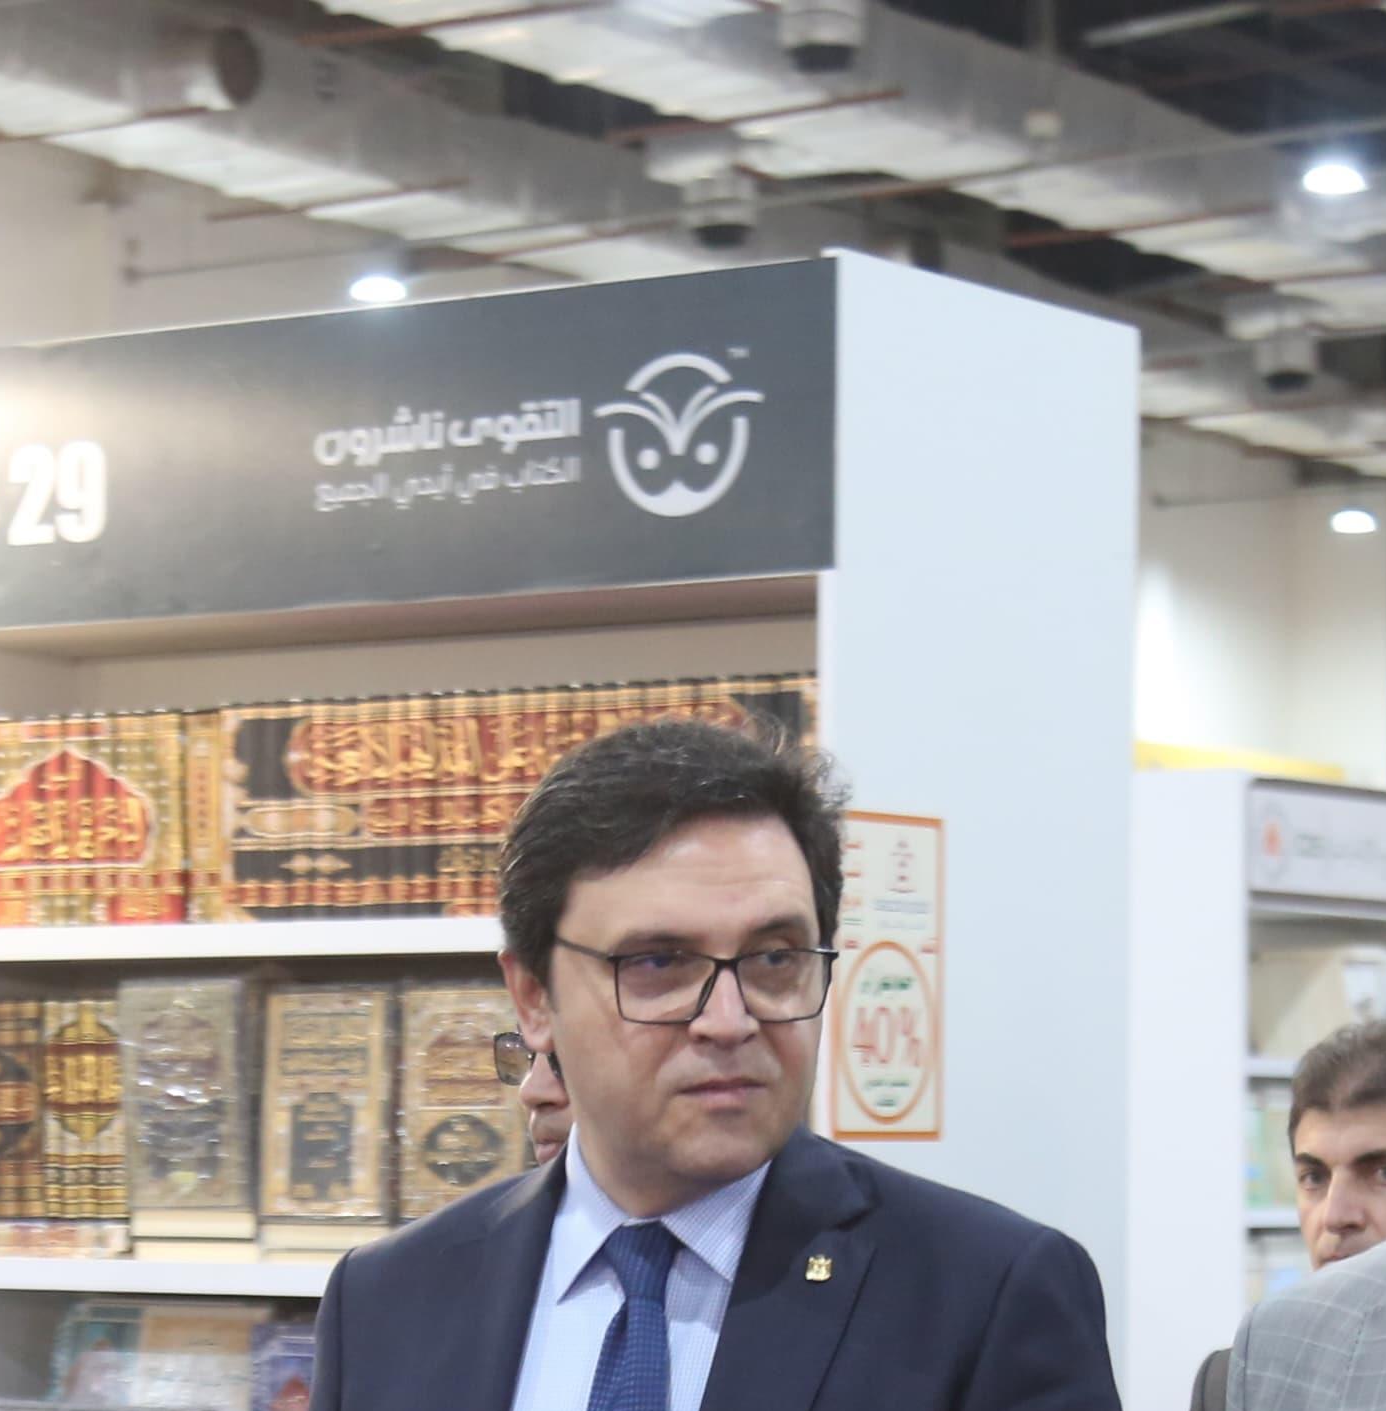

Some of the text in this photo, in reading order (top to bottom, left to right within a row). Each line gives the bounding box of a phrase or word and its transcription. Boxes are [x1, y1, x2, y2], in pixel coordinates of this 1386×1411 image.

[314, 397, 582, 467] التقوى ناشرون
[6, 440, 107, 547] 29
[315, 472, 390, 512] الجميع
[500, 456, 581, 494] الكتاب
